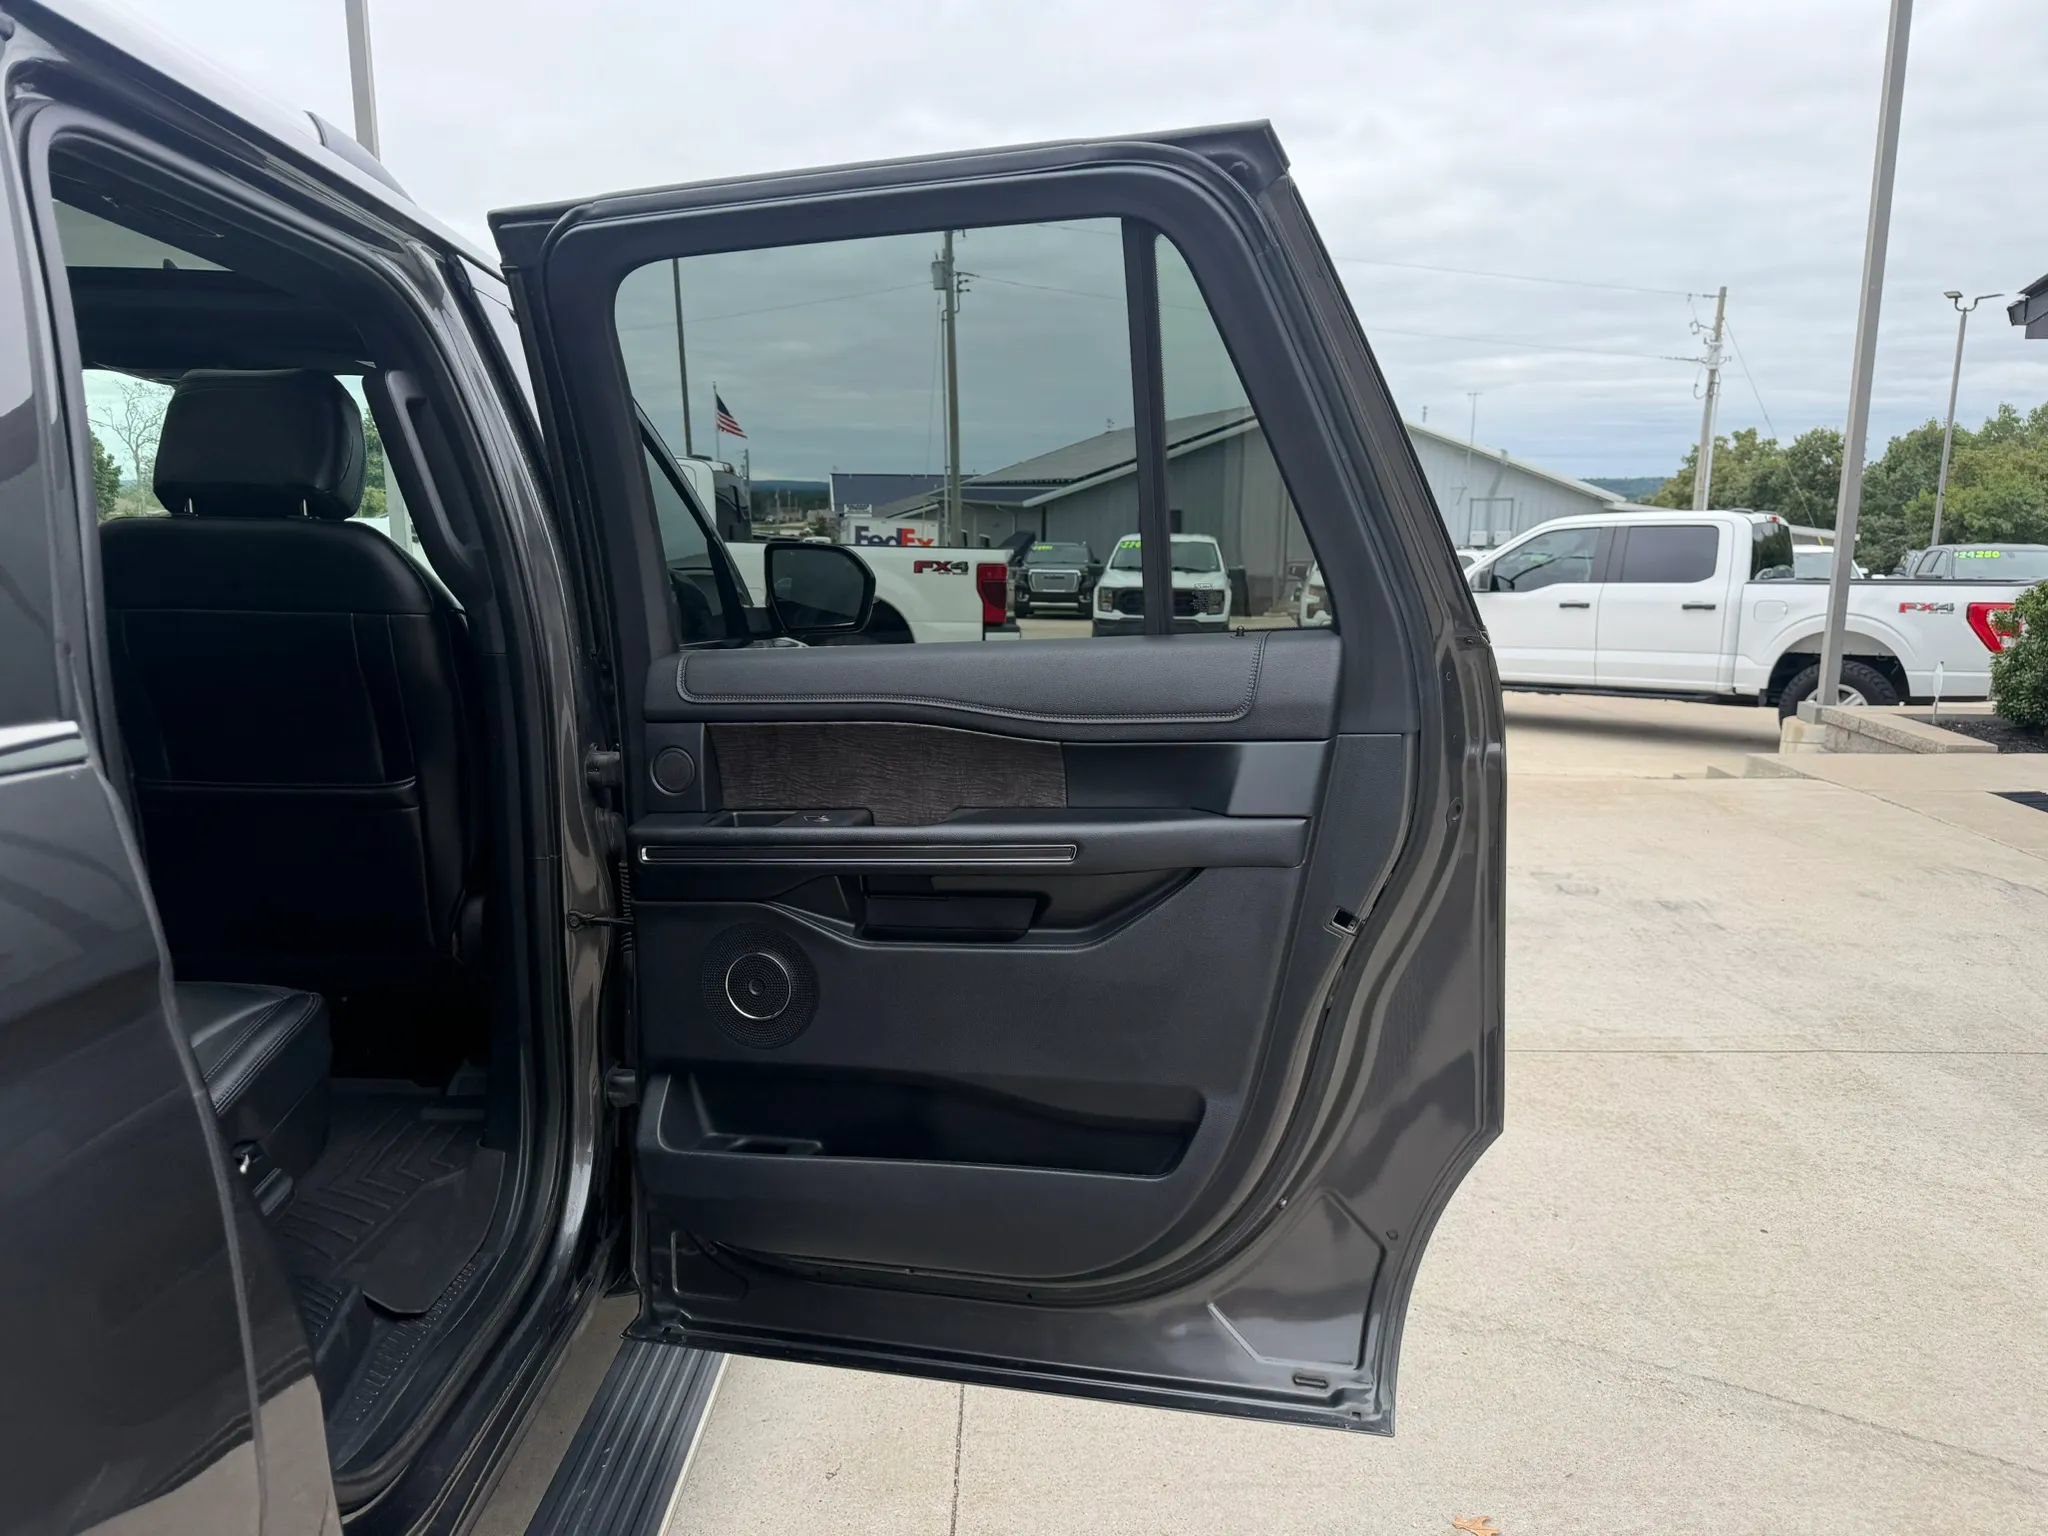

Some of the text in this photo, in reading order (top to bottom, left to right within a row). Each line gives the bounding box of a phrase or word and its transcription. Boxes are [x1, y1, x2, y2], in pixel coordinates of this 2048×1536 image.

[855, 526, 934, 547] FedEx
[914, 560, 969, 574] FX4
[1898, 602, 1955, 613] FX4
